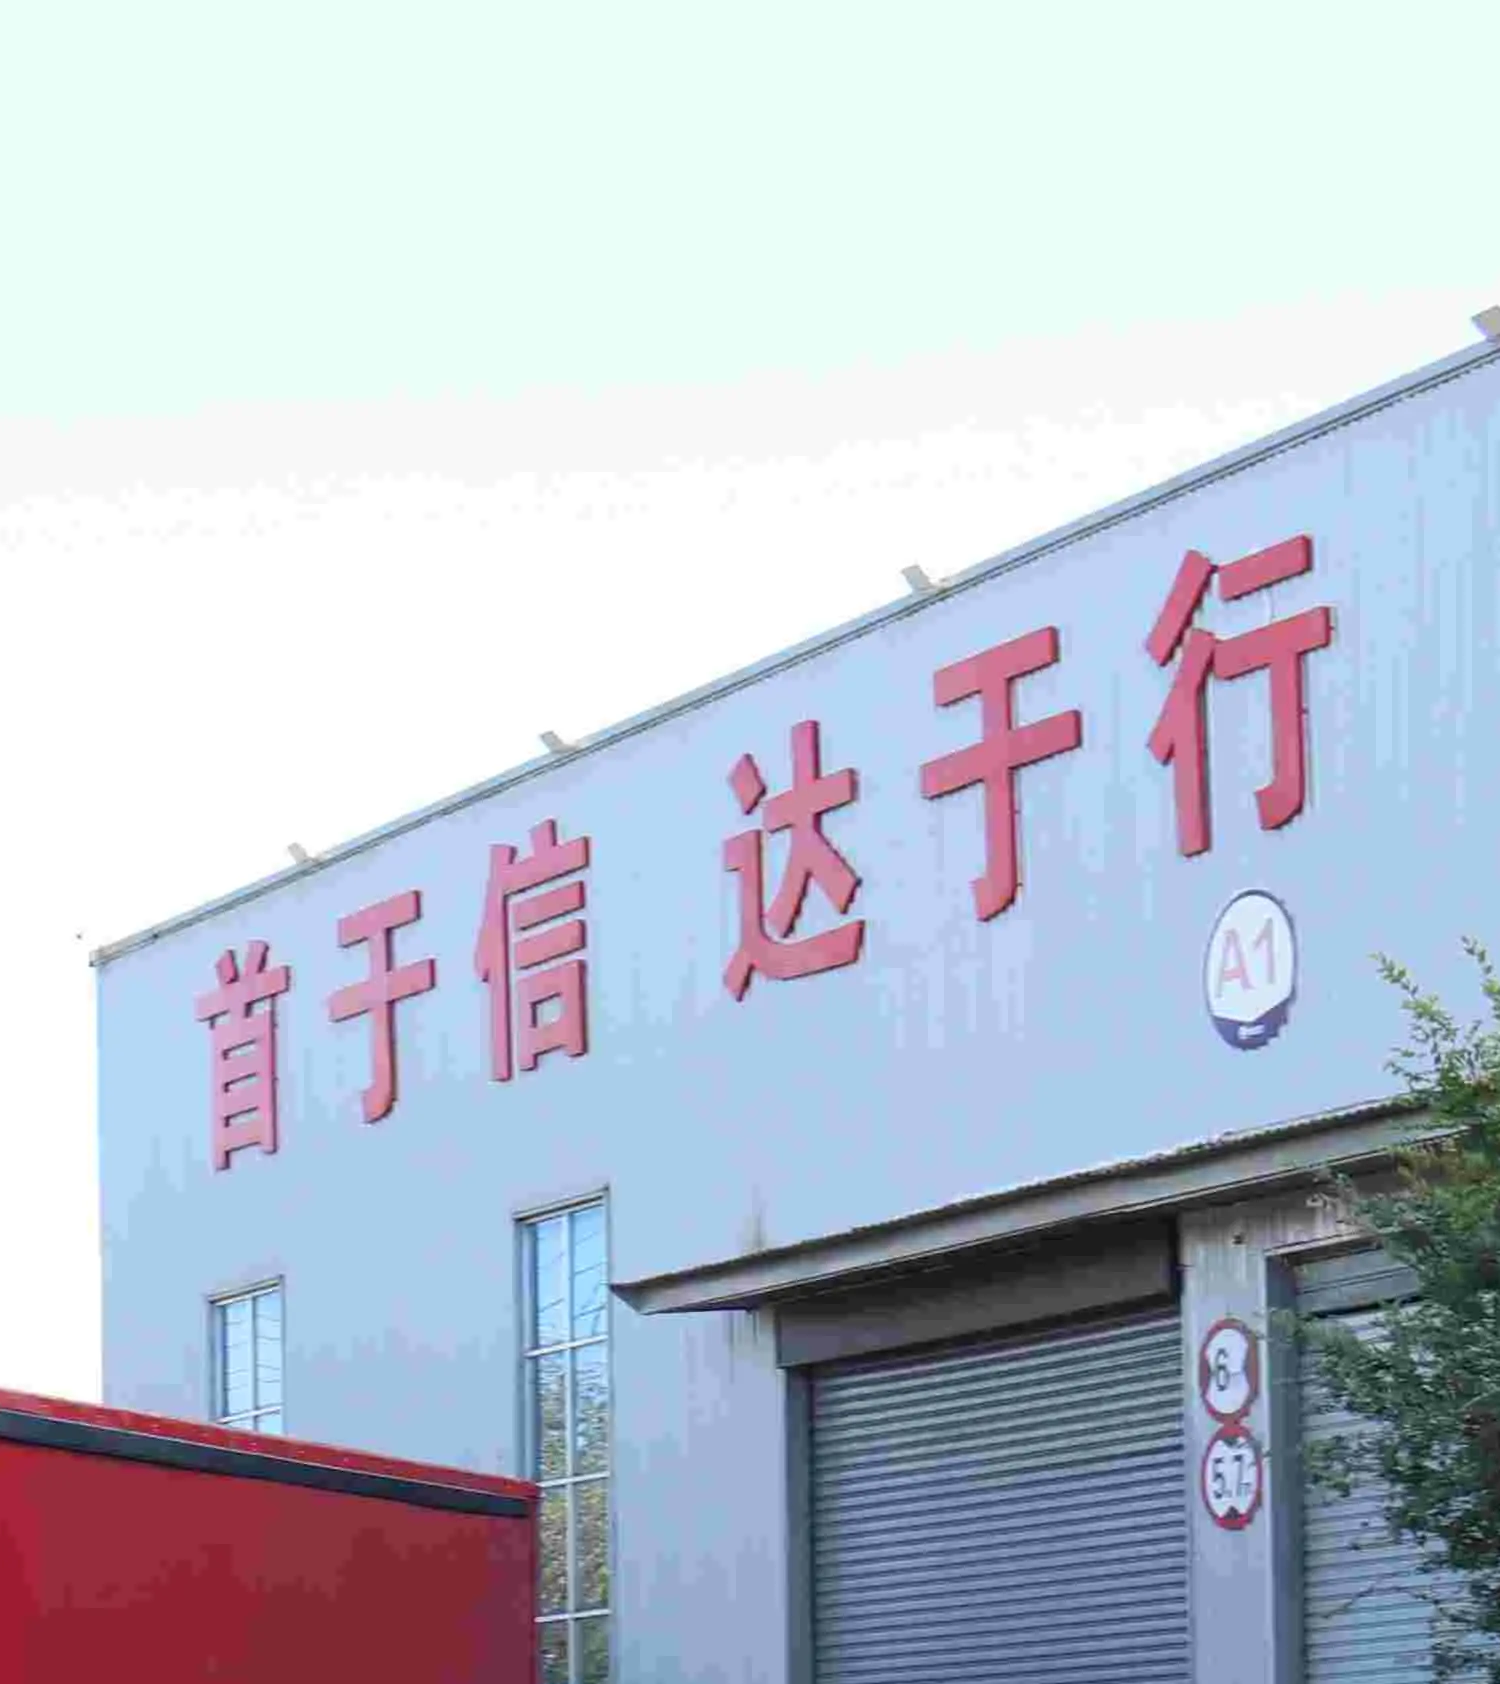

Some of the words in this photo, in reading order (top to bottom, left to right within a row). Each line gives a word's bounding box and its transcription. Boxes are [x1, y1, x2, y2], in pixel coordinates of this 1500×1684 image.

[196, 818, 591, 1170] 首于信
[722, 534, 1335, 1001] 达于行
[1215, 917, 1276, 998] A1
